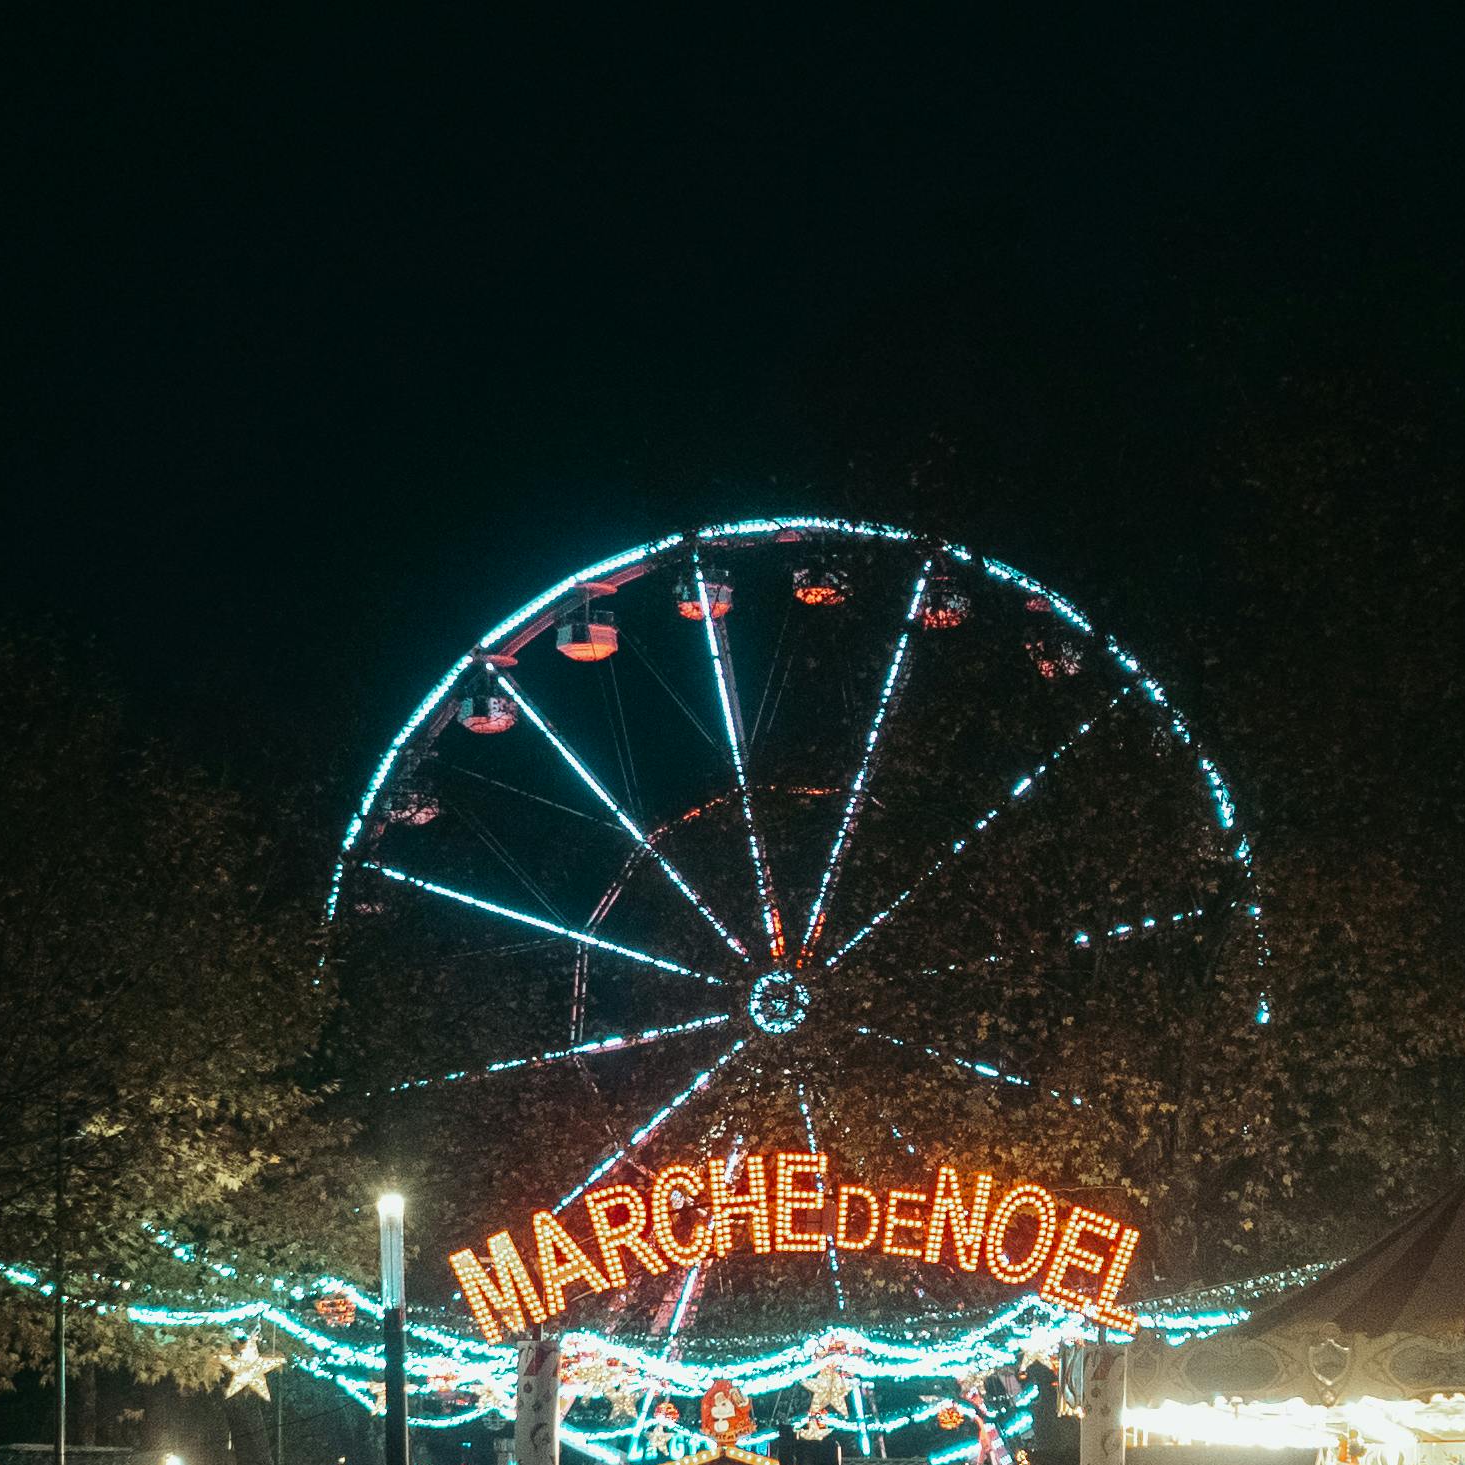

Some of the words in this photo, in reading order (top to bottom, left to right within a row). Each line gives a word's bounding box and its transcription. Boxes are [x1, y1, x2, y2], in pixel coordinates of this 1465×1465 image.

[449, 1153, 828, 1345] MARCHE
[836, 1184, 927, 1258] DE
[924, 1166, 1140, 1334] NOEL
